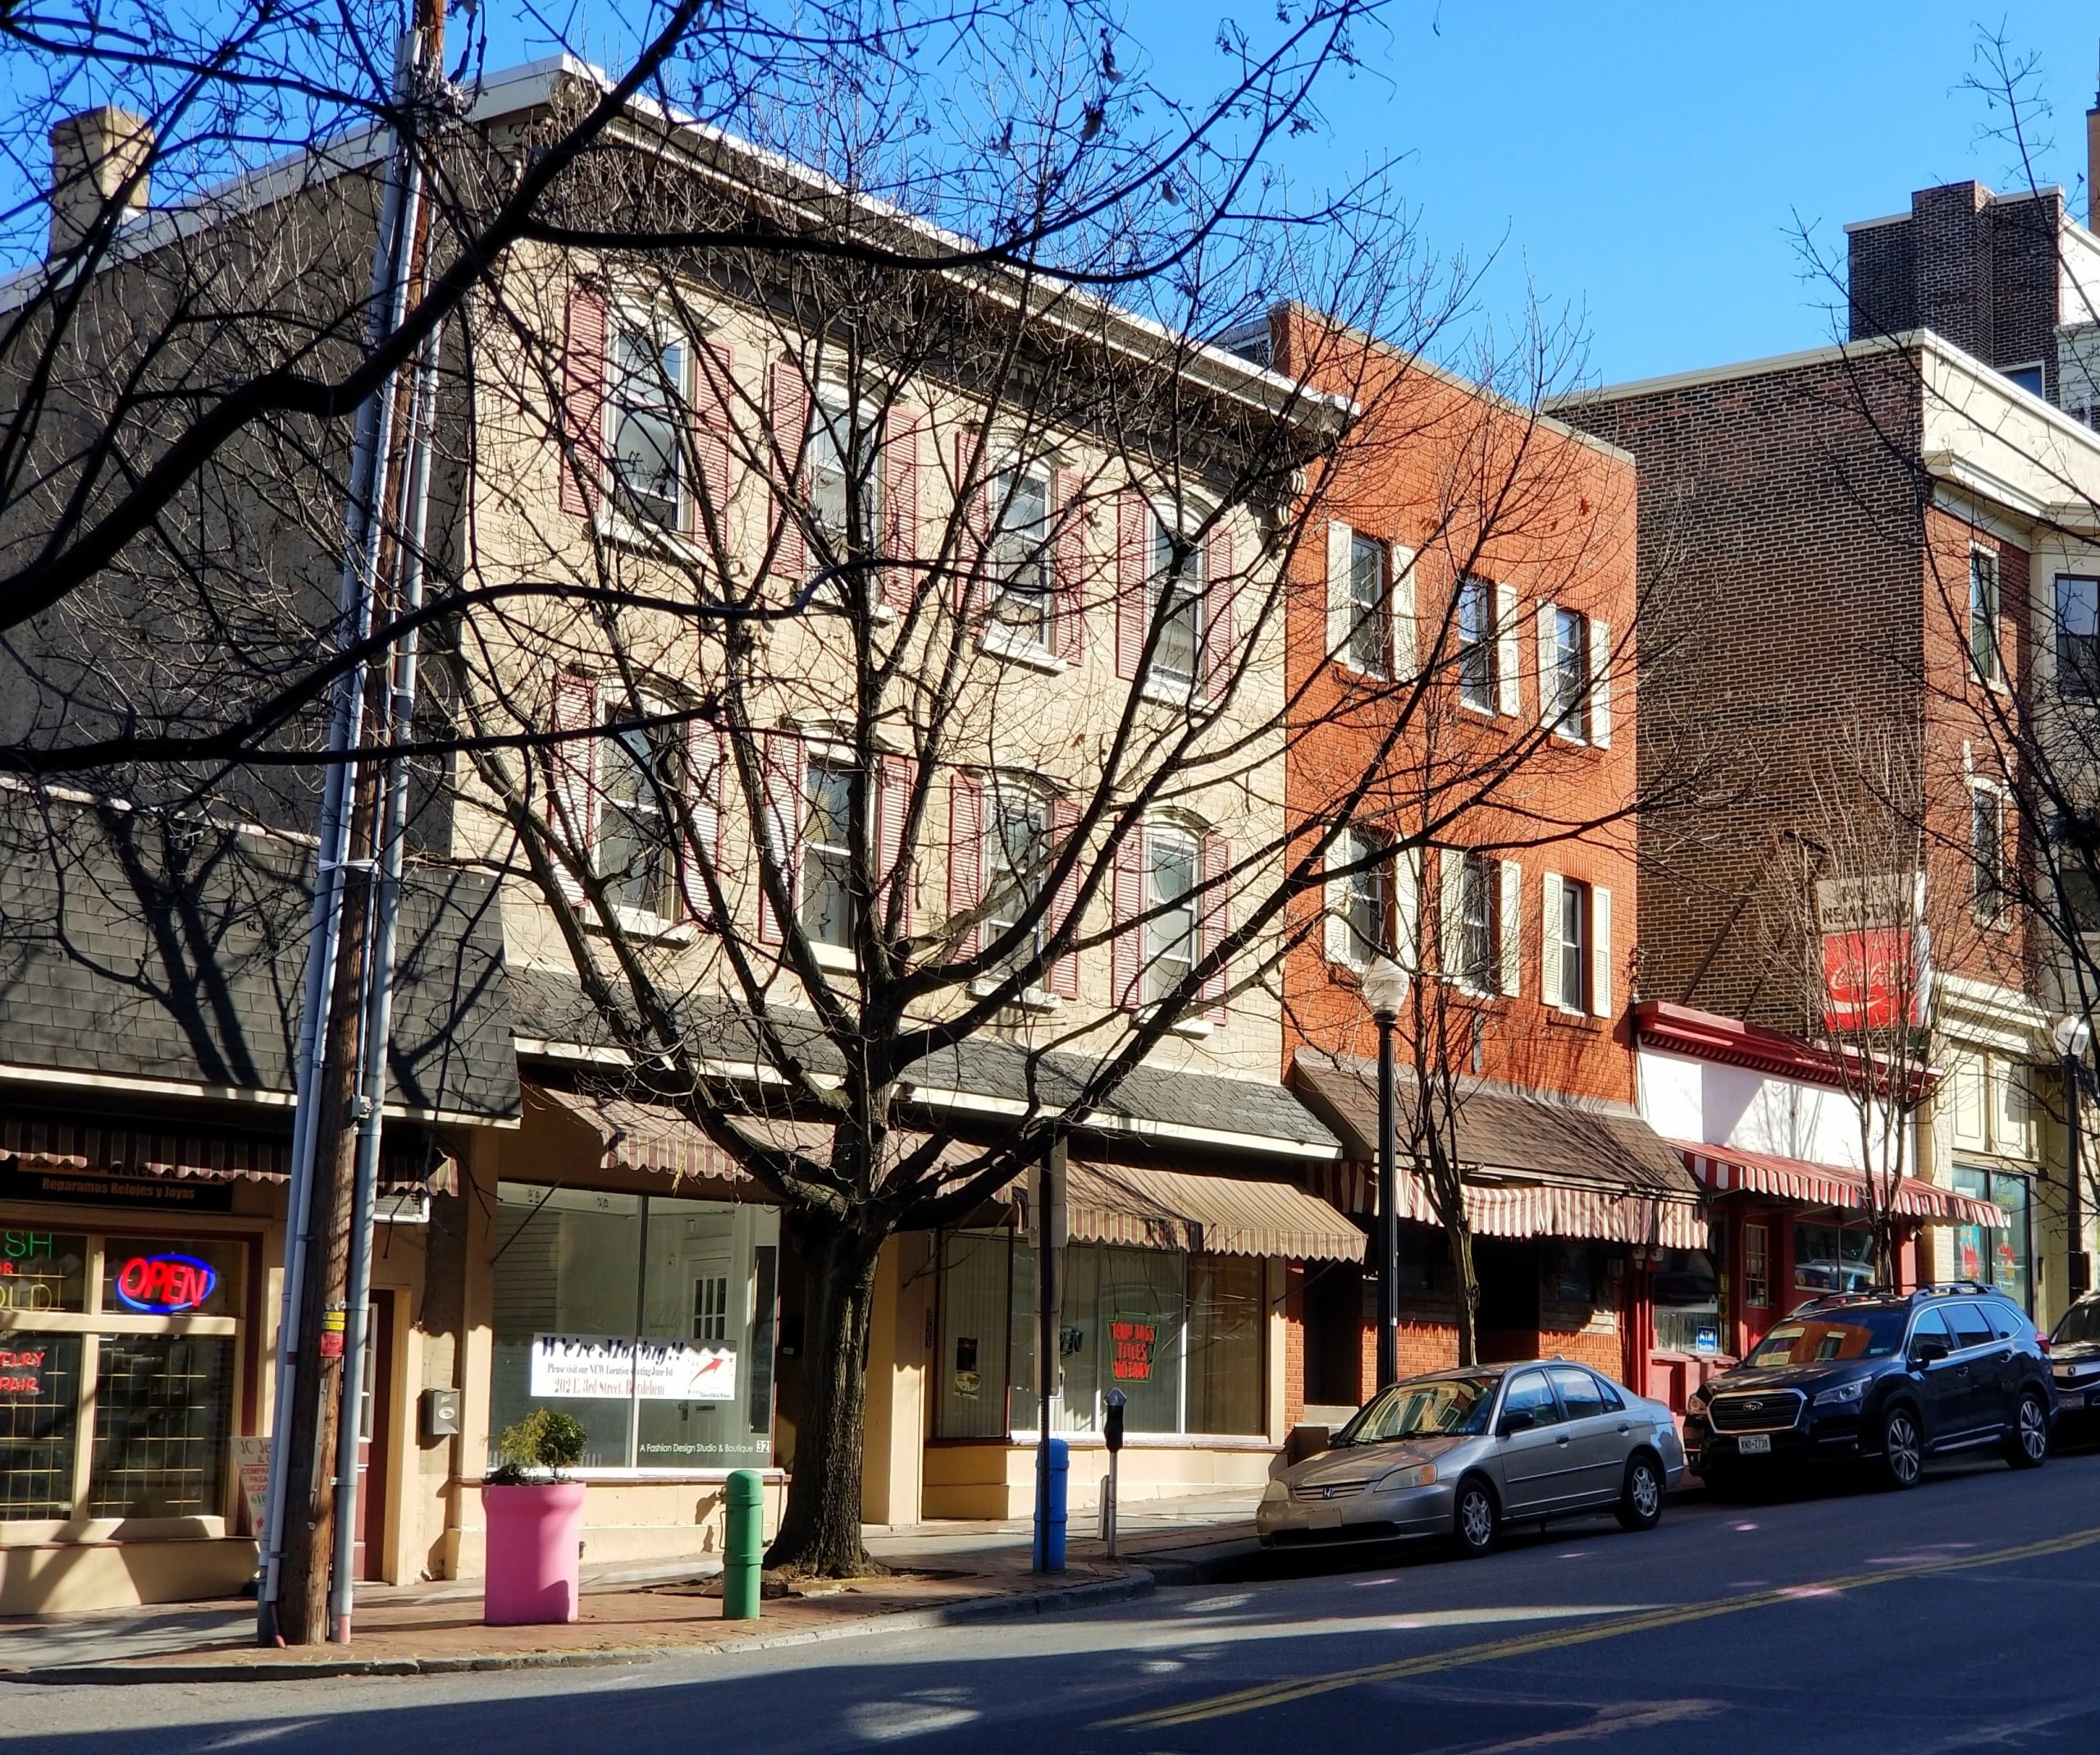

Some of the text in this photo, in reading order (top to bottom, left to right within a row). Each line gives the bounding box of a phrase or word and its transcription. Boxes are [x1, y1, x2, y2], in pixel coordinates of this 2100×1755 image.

[42, 1178, 196, 1200] Reparamos Relojes y Joyas
[121, 1257, 209, 1308] OPEN
[1060, 1329, 1083, 1353] PEN
[1699, 1329, 1714, 1342] ATM
[541, 1336, 596, 1359] We're
[1117, 1342, 1148, 1361] TITLES
[547, 1363, 565, 1374] Please
[566, 1364, 578, 1374] visit
[578, 1366, 589, 1375] our
[589, 1365, 605, 1375] NEW
[606, 1365, 630, 1376] Location
[651, 1366, 666, 1377] June
[1114, 1361, 1151, 1379] NOTARY
[554, 1378, 571, 1394] 202
[583, 1379, 597, 1395] 3rd
[626, 1380, 665, 1396] Bthlehem
[240, 1440, 254, 1455] JC
[639, 1443, 754, 1455] A Fashion Design Studio & Boutique
[258, 1455, 265, 1464] &
